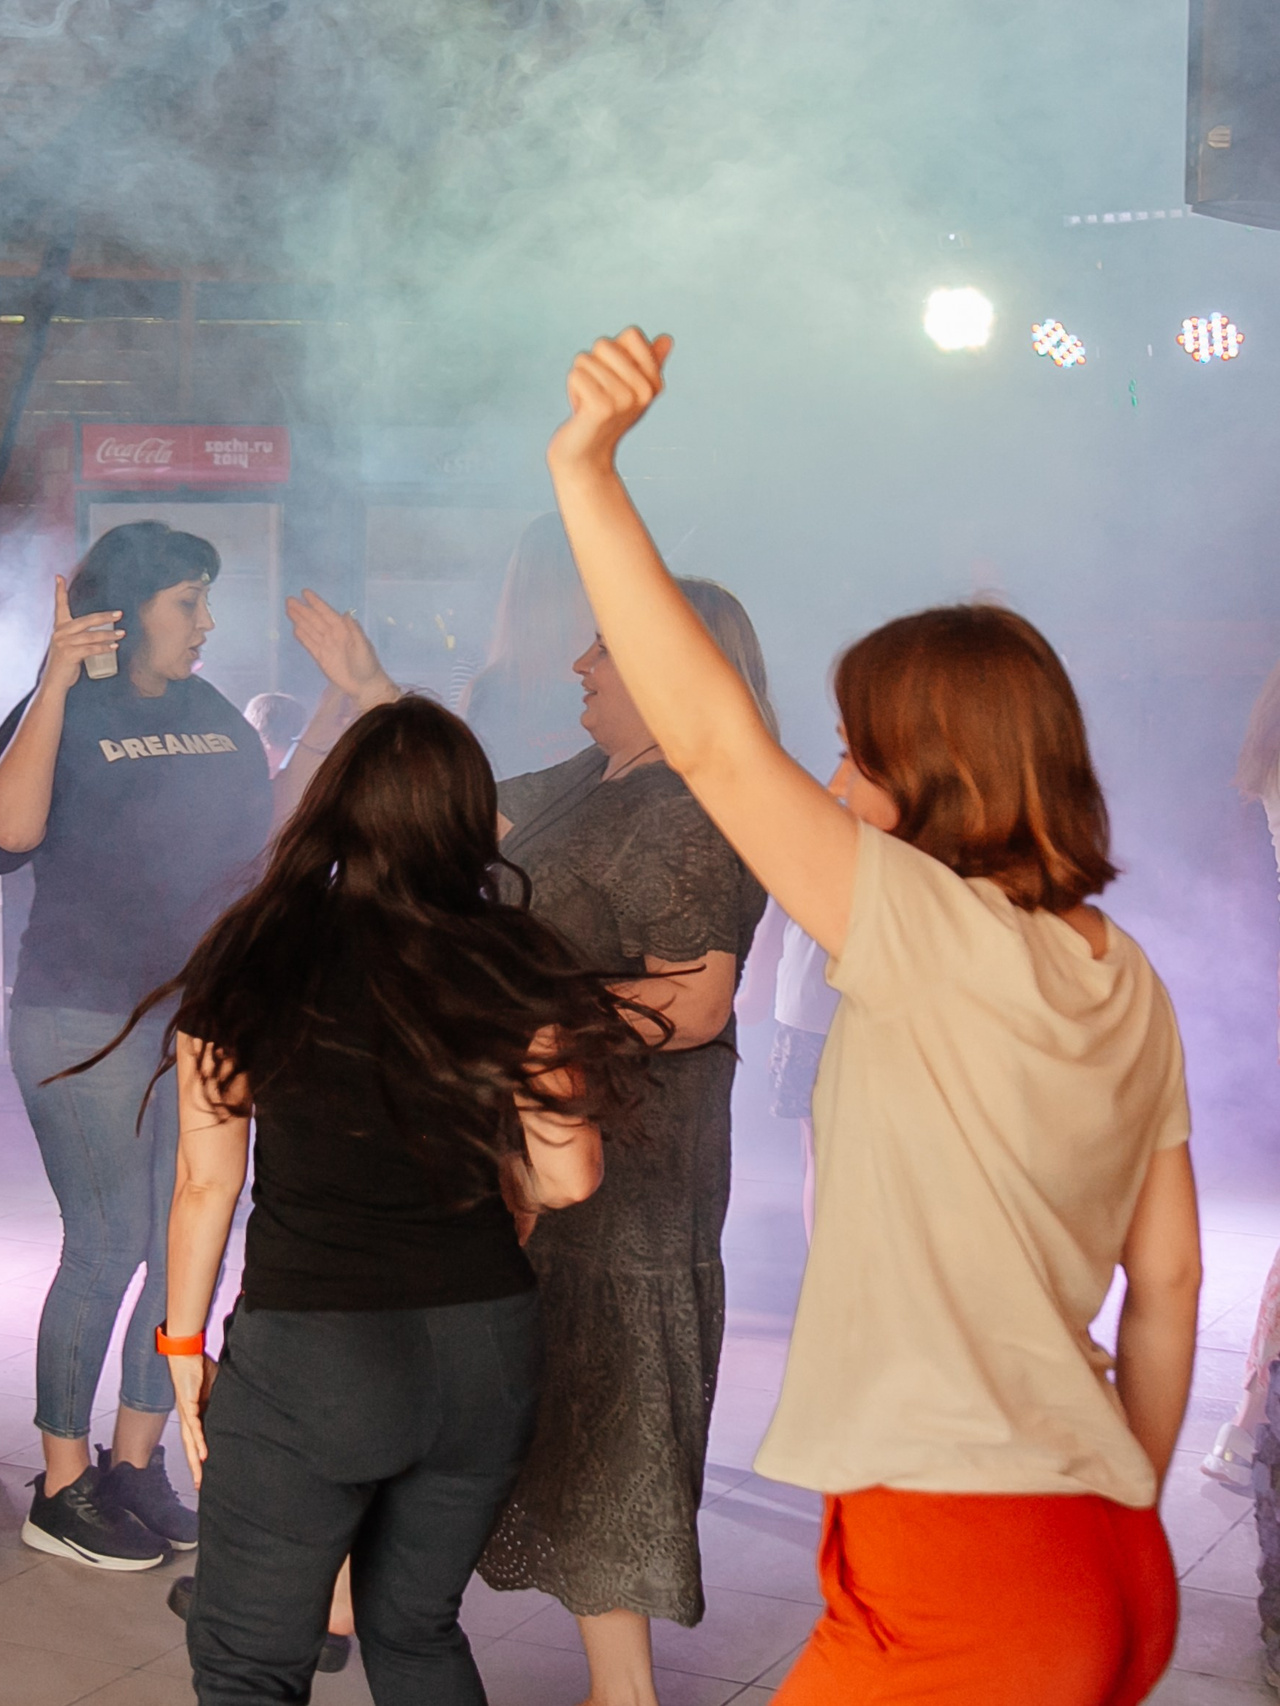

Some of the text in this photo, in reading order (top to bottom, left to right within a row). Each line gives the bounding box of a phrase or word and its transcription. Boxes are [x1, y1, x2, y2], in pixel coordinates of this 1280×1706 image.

[205, 438, 273, 454] sochi.ru
[213, 453, 249, 469] 2014
[99, 732, 238, 763] DREAMER
